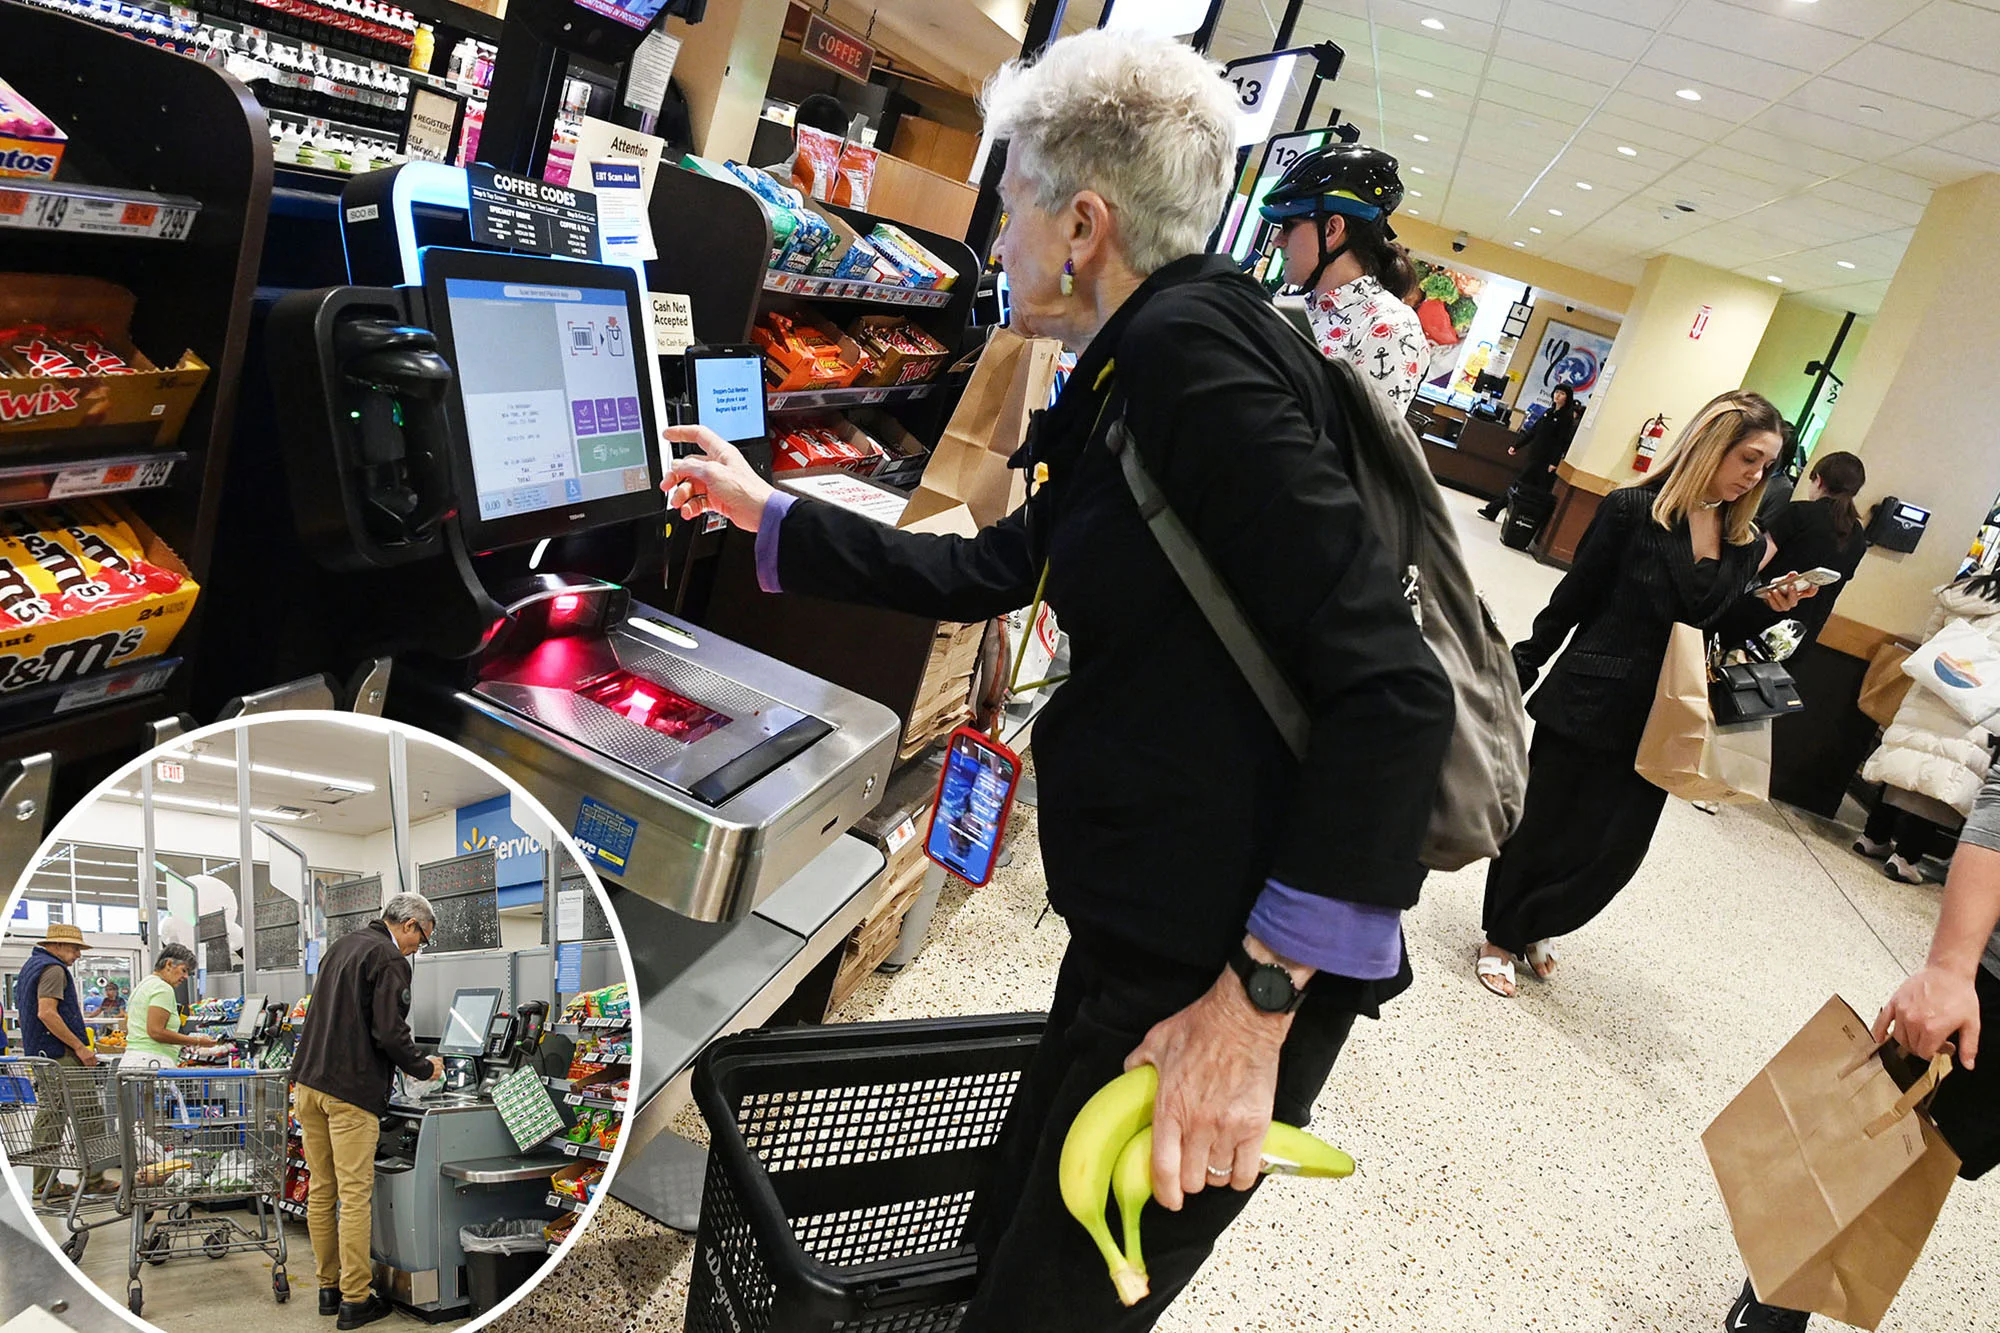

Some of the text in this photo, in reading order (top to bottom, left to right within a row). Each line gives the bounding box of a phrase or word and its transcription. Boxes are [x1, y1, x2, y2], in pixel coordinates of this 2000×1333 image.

[818, 31, 863, 69] COFFEE
[1232, 77, 1262, 106] 13
[418, 114, 451, 132] REGISTERS
[610, 136, 649, 158] Attention
[1276, 147, 1299, 168] 12
[493, 173, 577, 207] COFFEE CODES
[653, 299, 687, 314] Cash Not
[654, 314, 689, 328] Accepted
[137, 605, 164, 622] 24
[163, 765, 180, 780] EXIT
[488, 834, 545, 860] Servic
